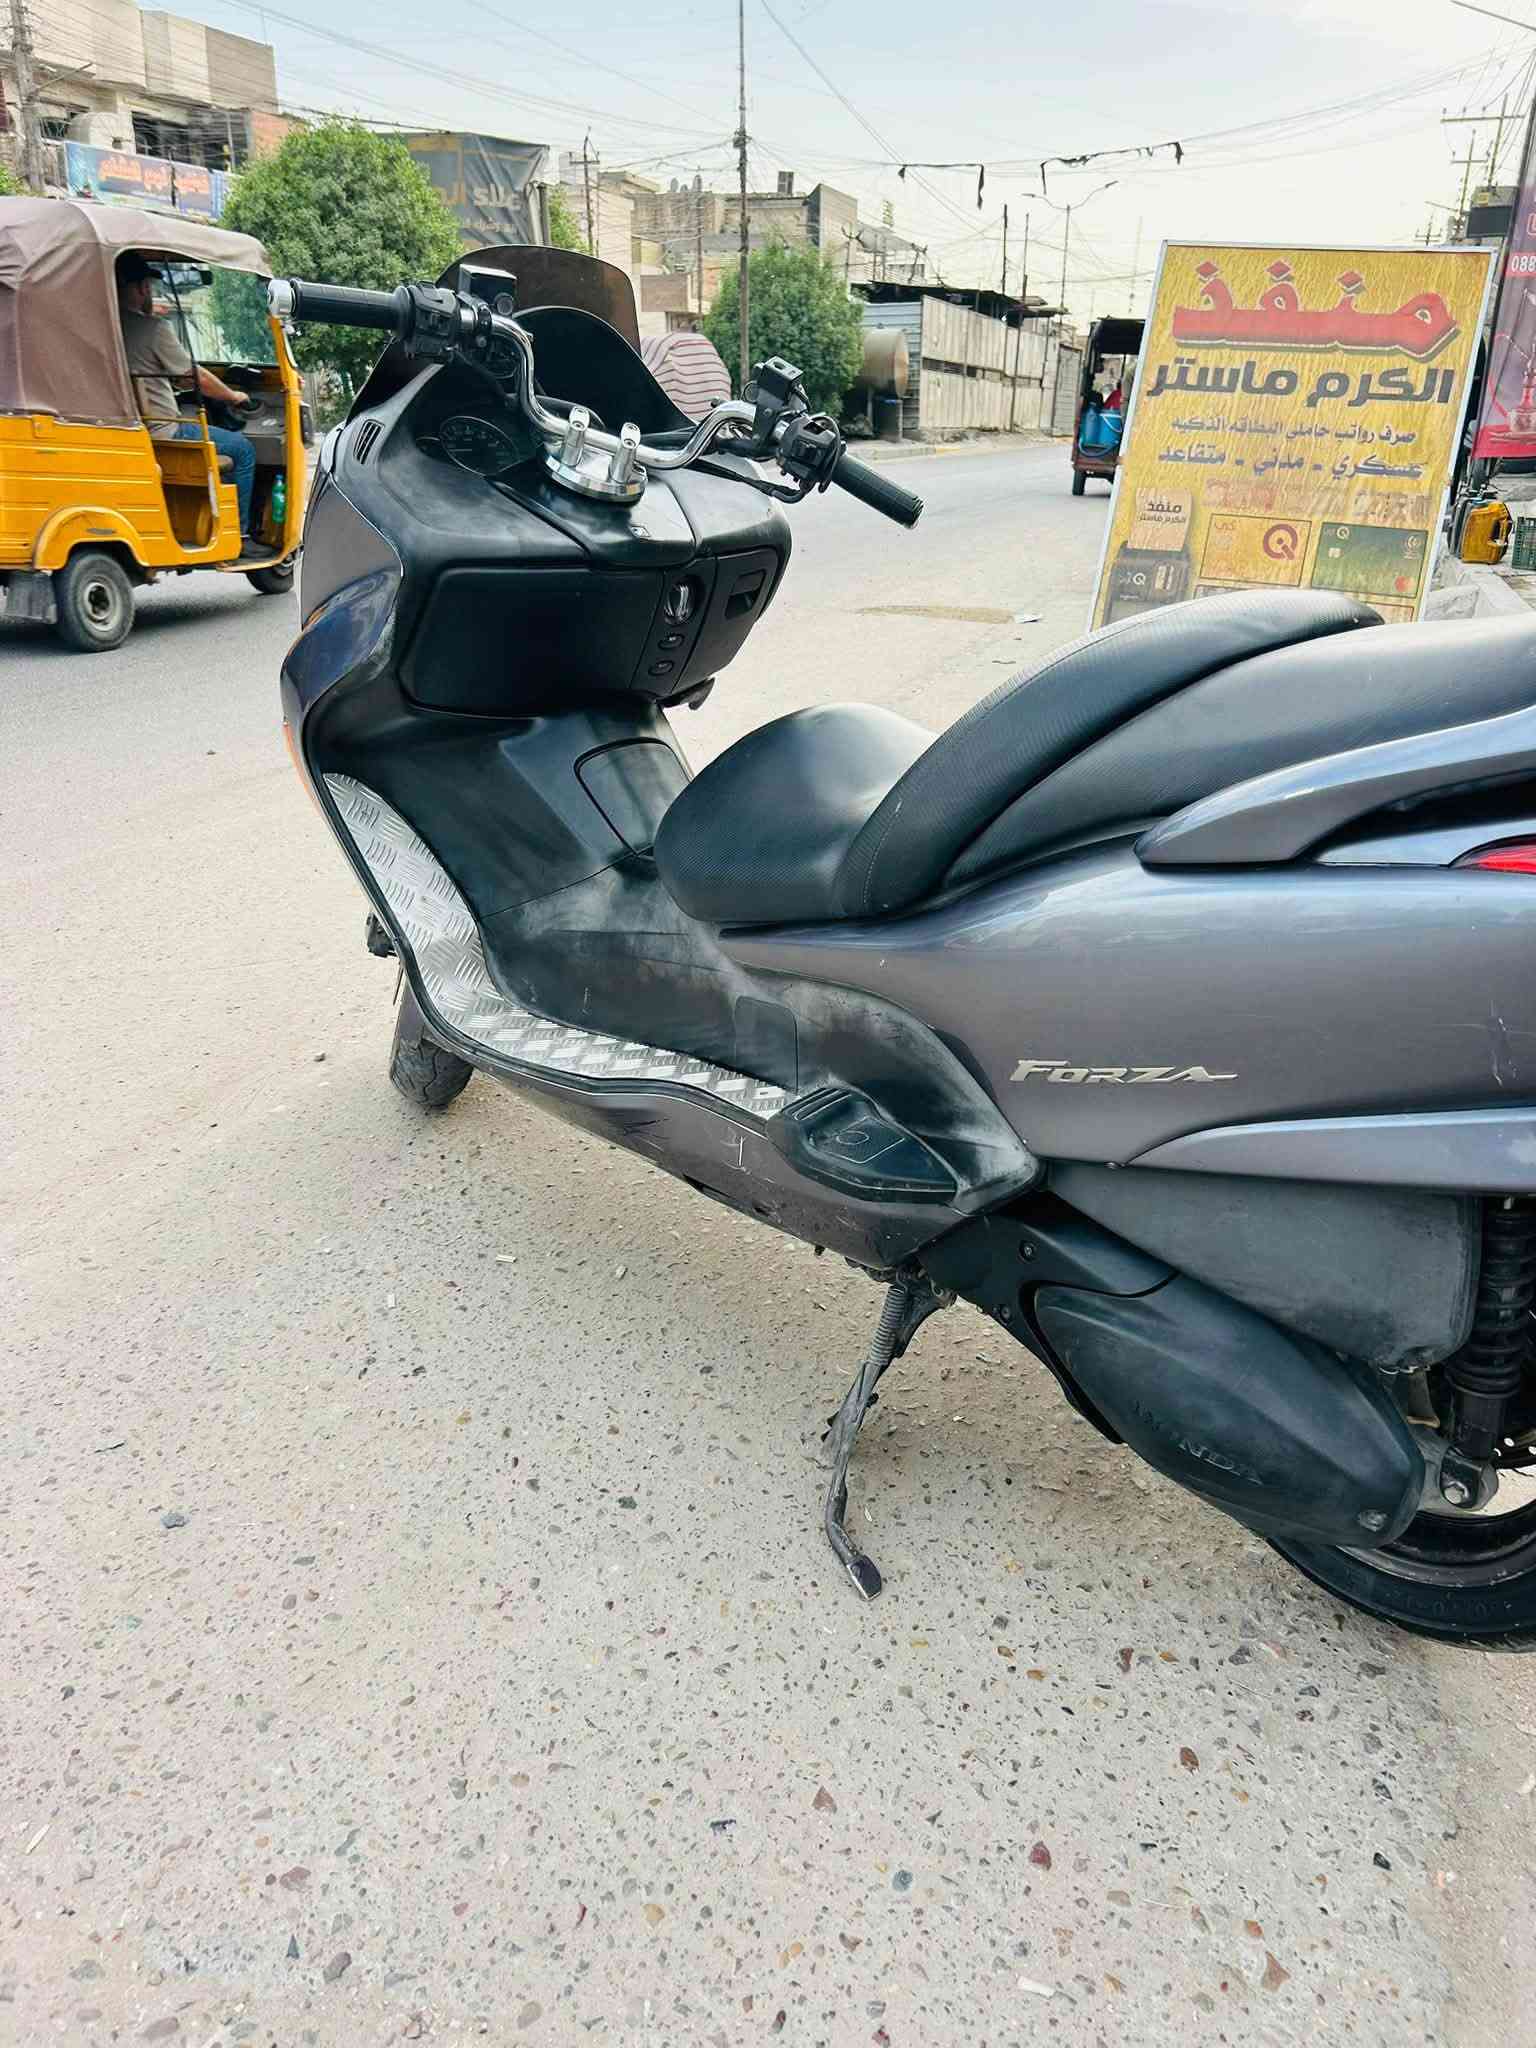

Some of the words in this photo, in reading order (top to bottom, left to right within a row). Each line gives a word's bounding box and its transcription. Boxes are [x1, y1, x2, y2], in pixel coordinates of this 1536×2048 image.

[1172, 260, 1461, 363] منفذ
[1146, 357, 1298, 397] ماستر
[1305, 367, 1456, 408] الكرم
[1334, 422, 1375, 444] رواتب
[1377, 425, 1417, 446] صرف
[1158, 442, 1226, 466] متقاعد
[1254, 447, 1305, 476] مدني
[1332, 452, 1426, 480] عسكري
[1009, 1059, 1239, 1084] FORZA
